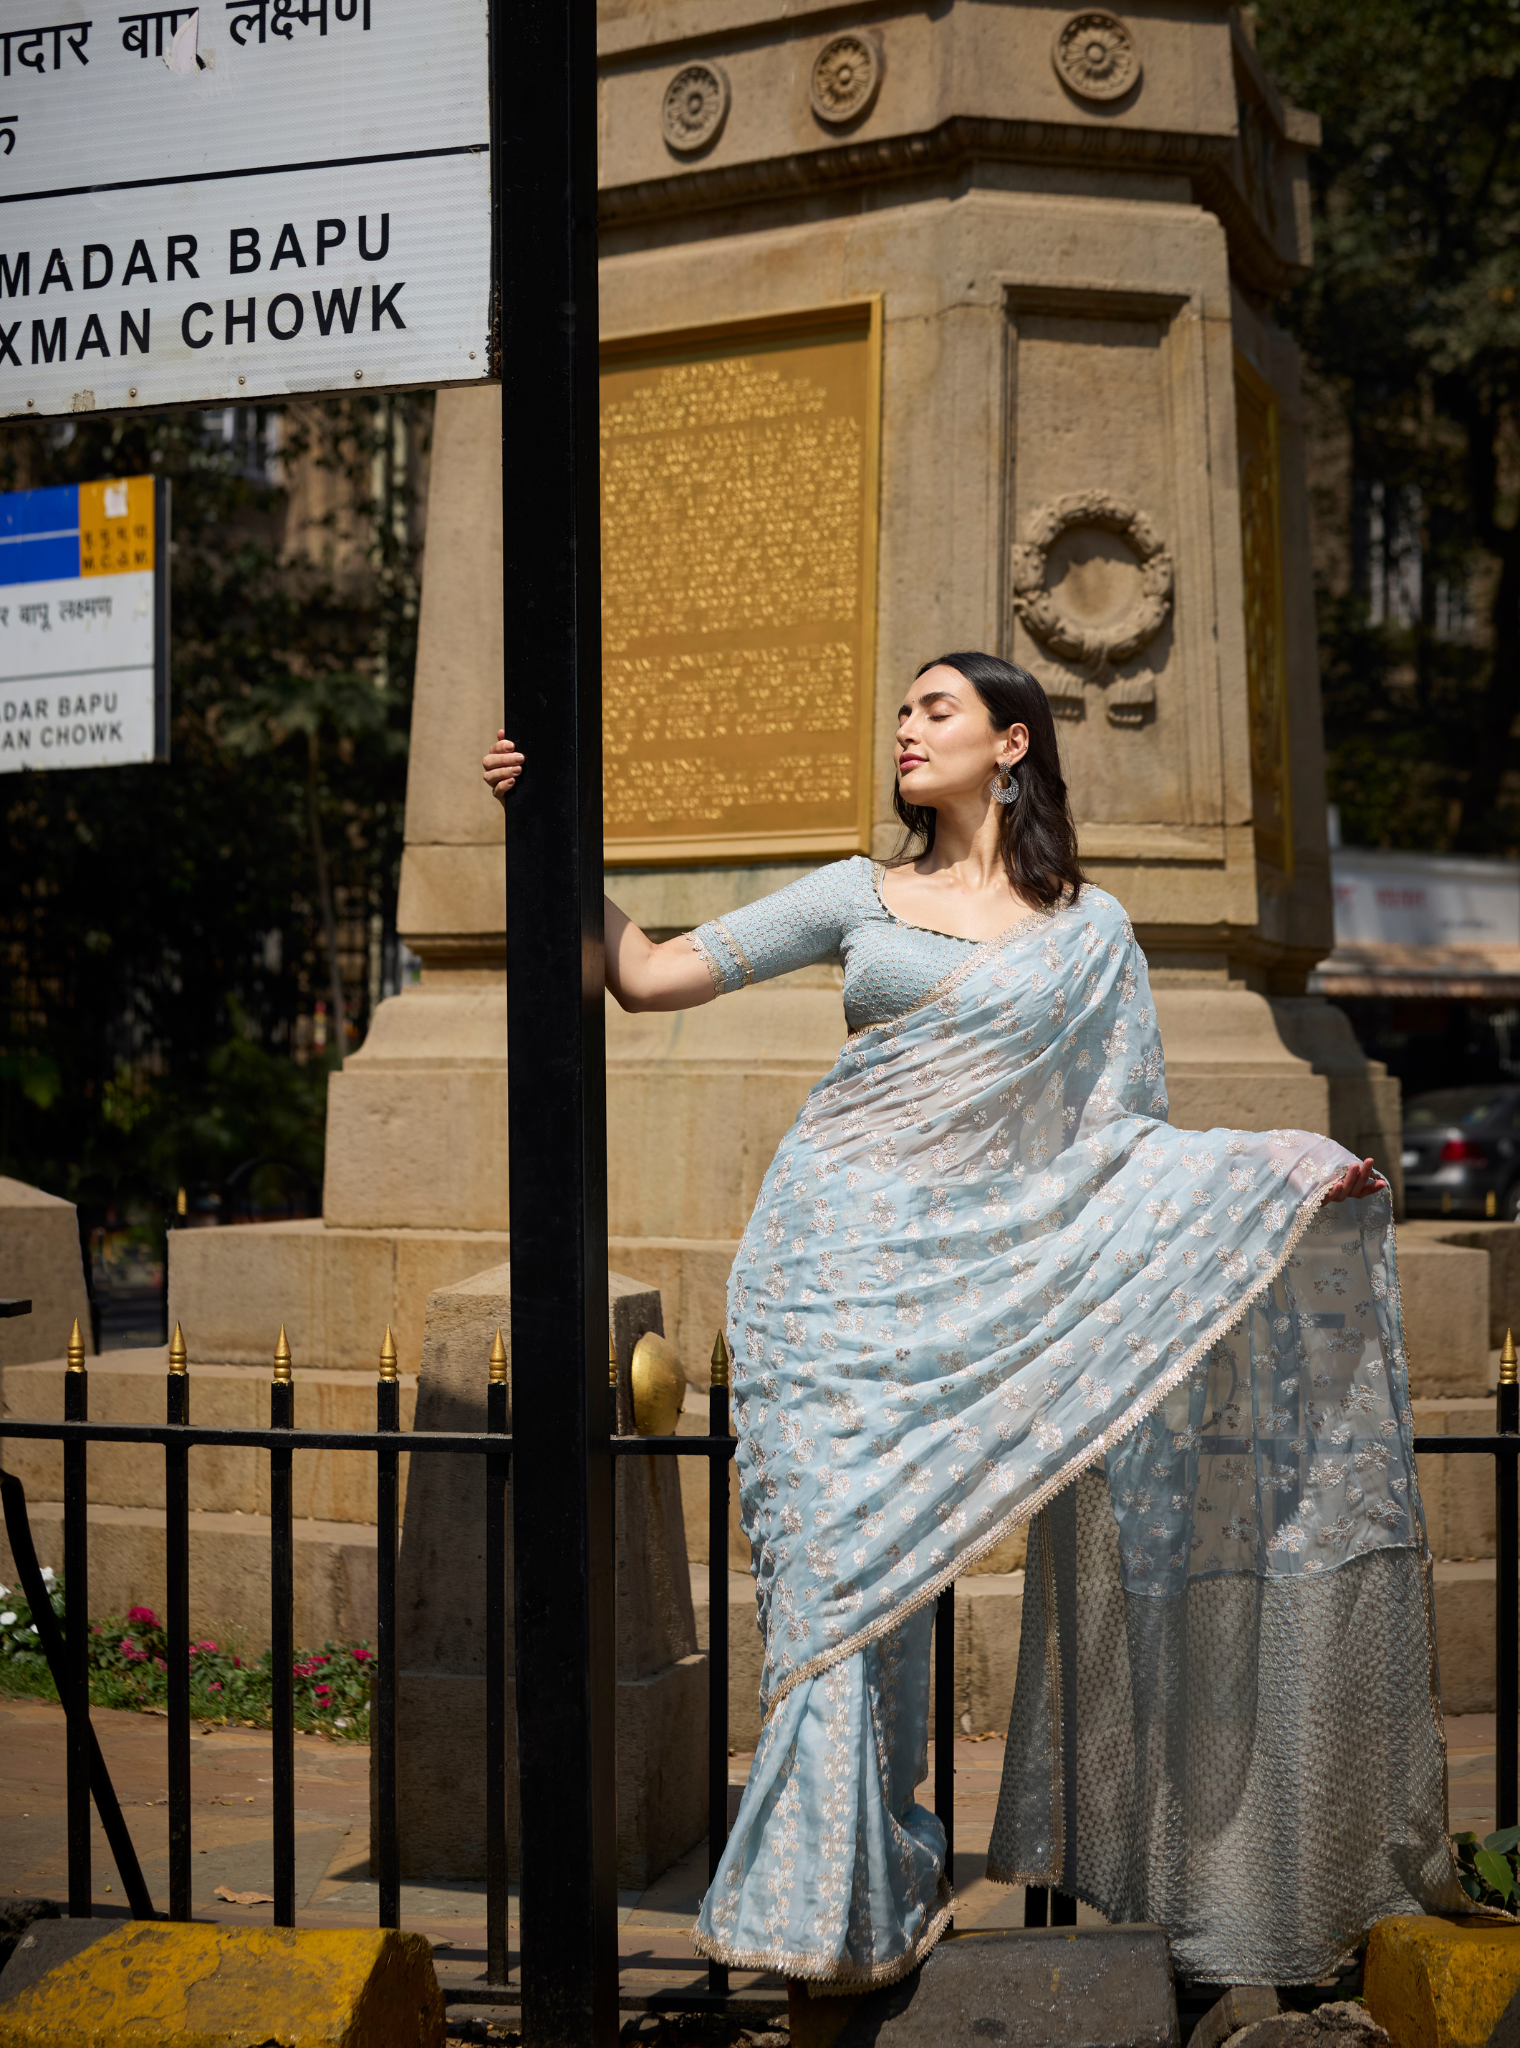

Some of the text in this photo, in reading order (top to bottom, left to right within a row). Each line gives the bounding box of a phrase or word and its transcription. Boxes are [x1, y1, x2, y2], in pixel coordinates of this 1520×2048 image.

[0, 213, 391, 299] MADAR BAPU
[181, 282, 407, 350] CHOWK
[0, 691, 119, 724] DAR BAPU
[40, 721, 123, 749] CHOWK
